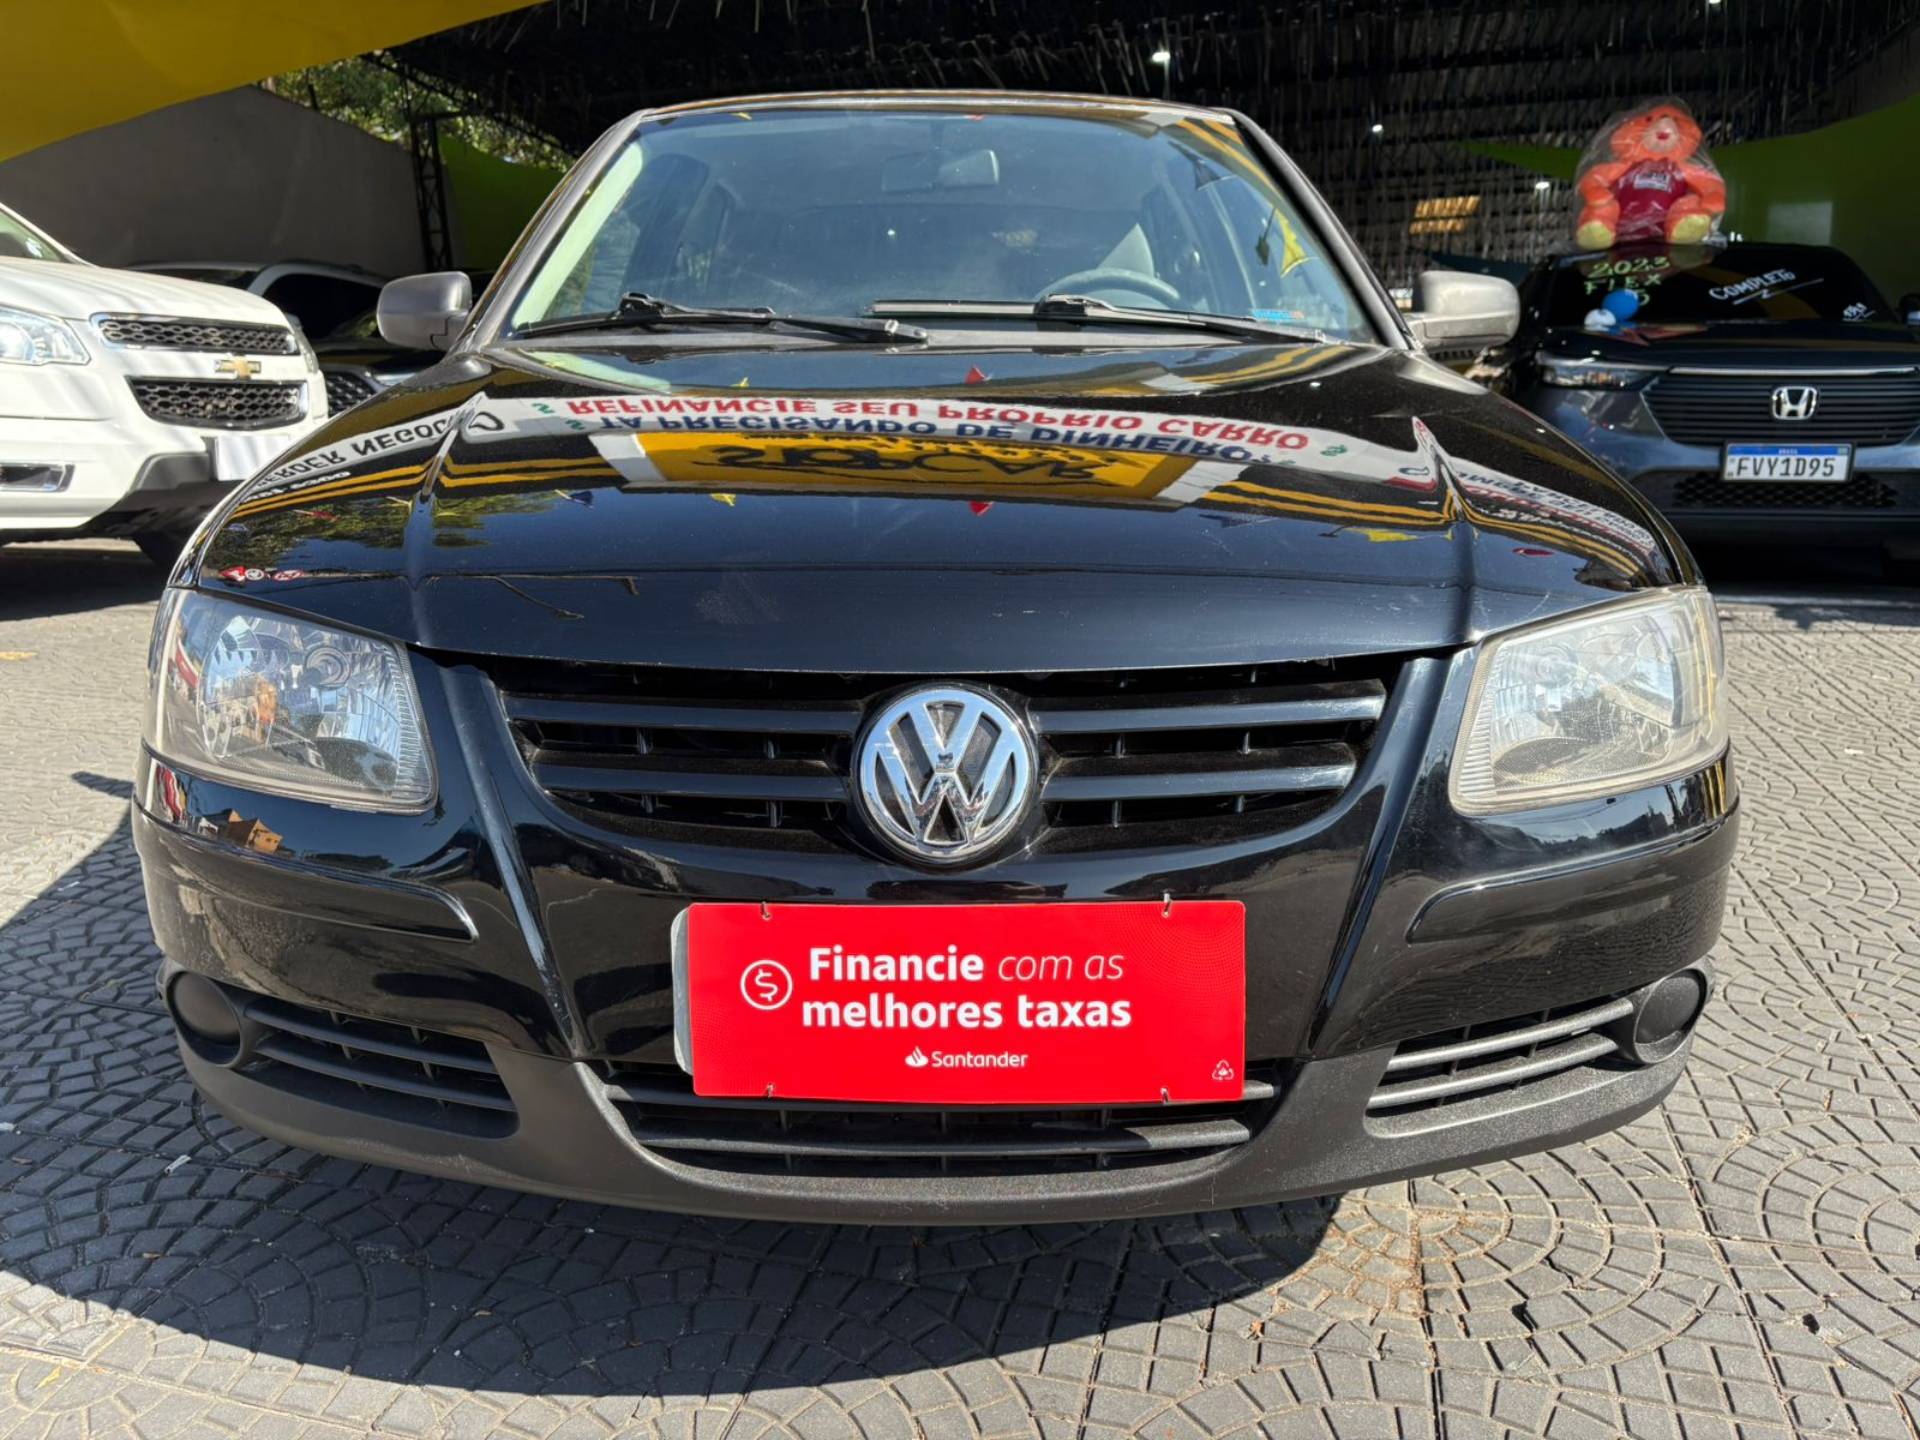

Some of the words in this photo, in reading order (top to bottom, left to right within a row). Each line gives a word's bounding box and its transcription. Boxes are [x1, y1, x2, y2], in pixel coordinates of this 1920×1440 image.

[1587, 256, 1670, 278] 2023
[1736, 457, 1836, 477] FVY1D95
[810, 945, 984, 981] Financie
[998, 956, 1072, 980] com
[1085, 955, 1123, 980] as
[803, 993, 1003, 1028] melhores
[1018, 995, 1131, 1028] taxas
[932, 1051, 1028, 1067] Santander
